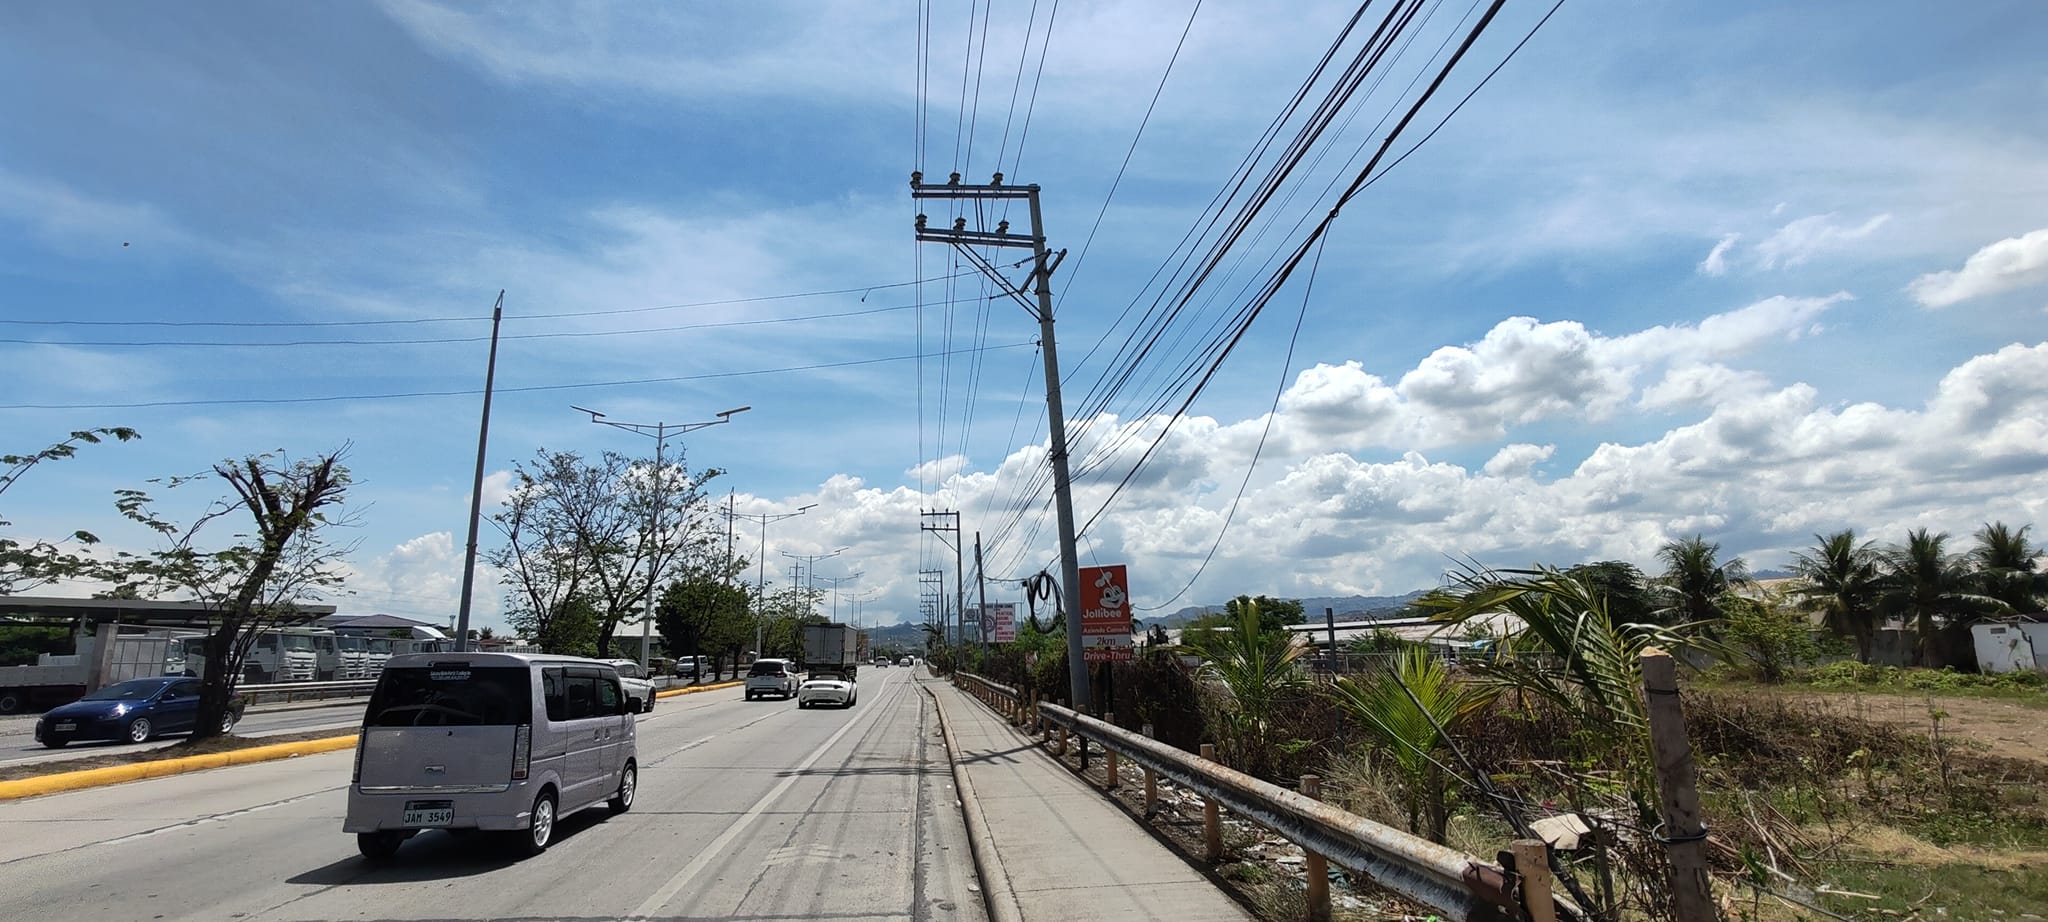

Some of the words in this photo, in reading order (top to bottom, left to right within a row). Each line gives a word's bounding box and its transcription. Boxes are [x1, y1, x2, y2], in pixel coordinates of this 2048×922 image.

[1082, 608, 1122, 619] Jollibee
[1096, 636, 1116, 646] 2km
[405, 813, 422, 824] JAM
[428, 811, 451, 823] 3549
